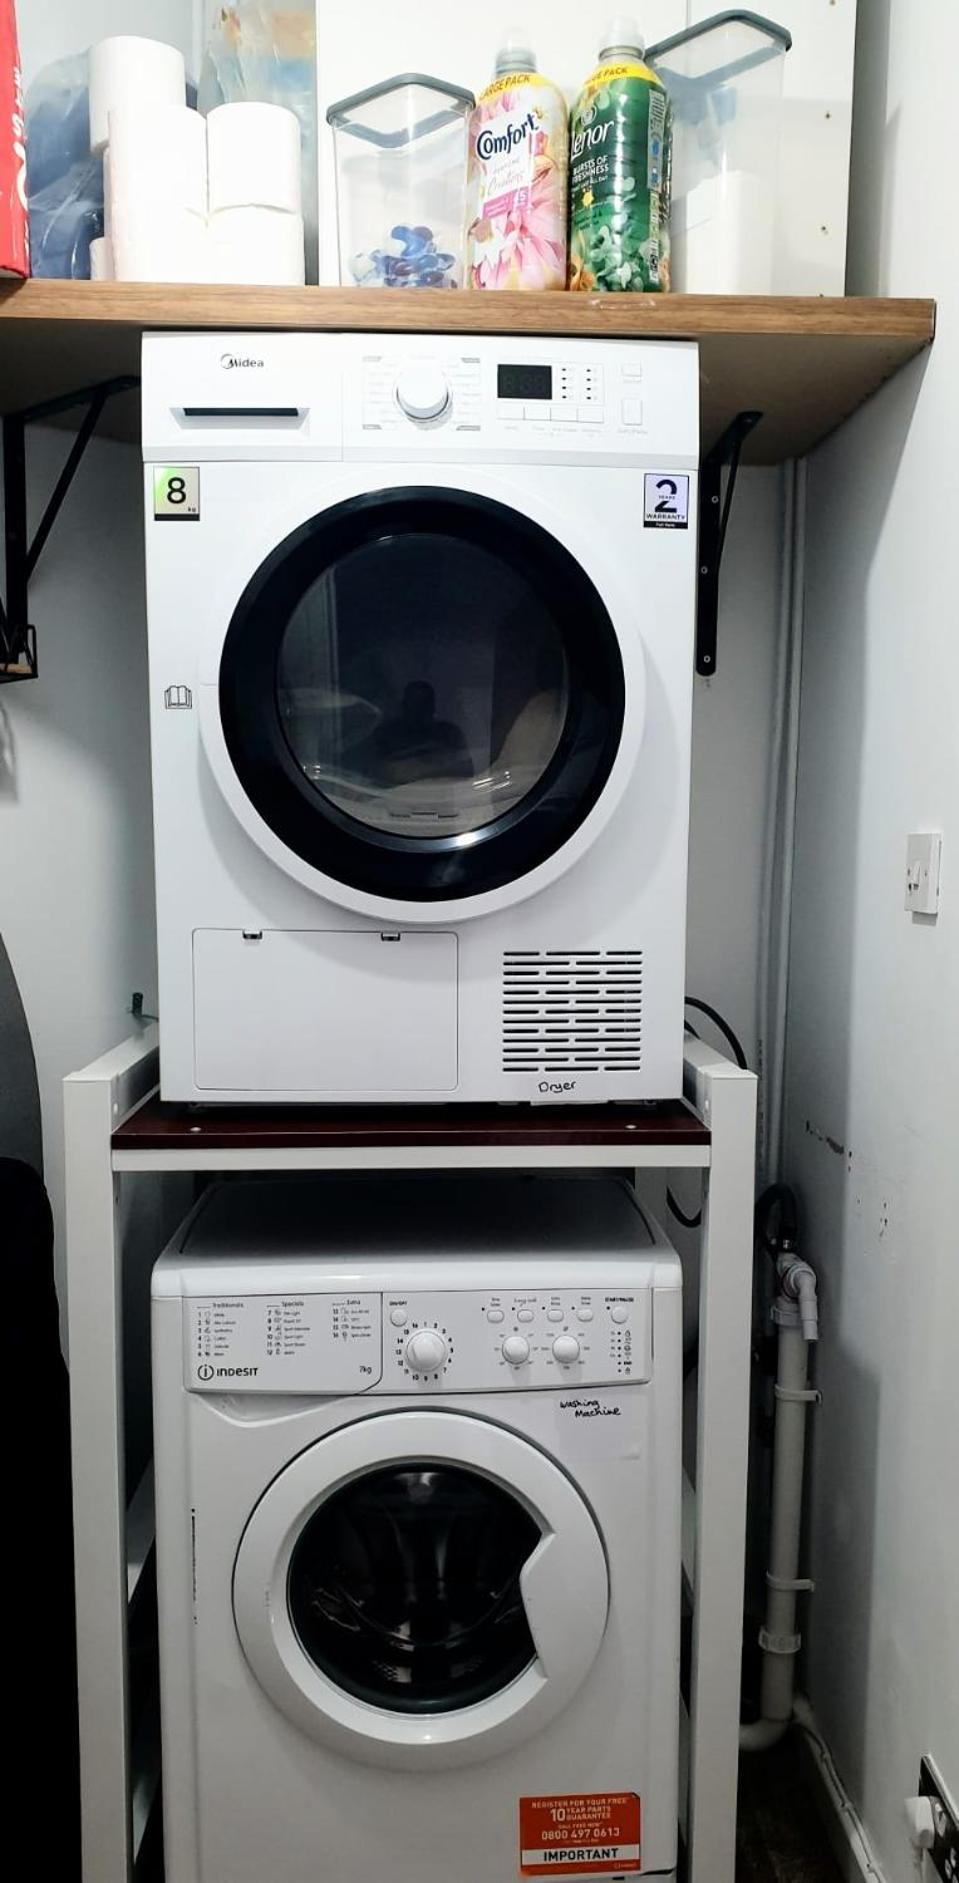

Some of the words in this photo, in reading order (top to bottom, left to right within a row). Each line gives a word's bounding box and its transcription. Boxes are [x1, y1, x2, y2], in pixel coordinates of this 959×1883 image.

[477, 113, 539, 160] Comfort
[597, 154, 609, 166] OF
[222, 354, 265, 369] Midea
[167, 477, 187, 504] 8
[655, 479, 678, 513] 2
[646, 513, 686, 521] WARRANTY
[537, 1081, 577, 1094] Dryer
[216, 1367, 258, 1377] INDESIT
[575, 1407, 621, 1418] Machine
[531, 1801, 569, 1809] REGISTER
[569, 1799, 585, 1807] FOR
[586, 1798, 606, 1806] YOUR
[550, 1808, 566, 1822] 10
[586, 1805, 611, 1813] PARTS
[566, 1812, 611, 1821] GUARANTEE
[541, 1830, 569, 1840] 0800
[570, 1828, 591, 1839] 497
[593, 1827, 620, 1838] 0613
[543, 1848, 619, 1862] IMPORTANT
